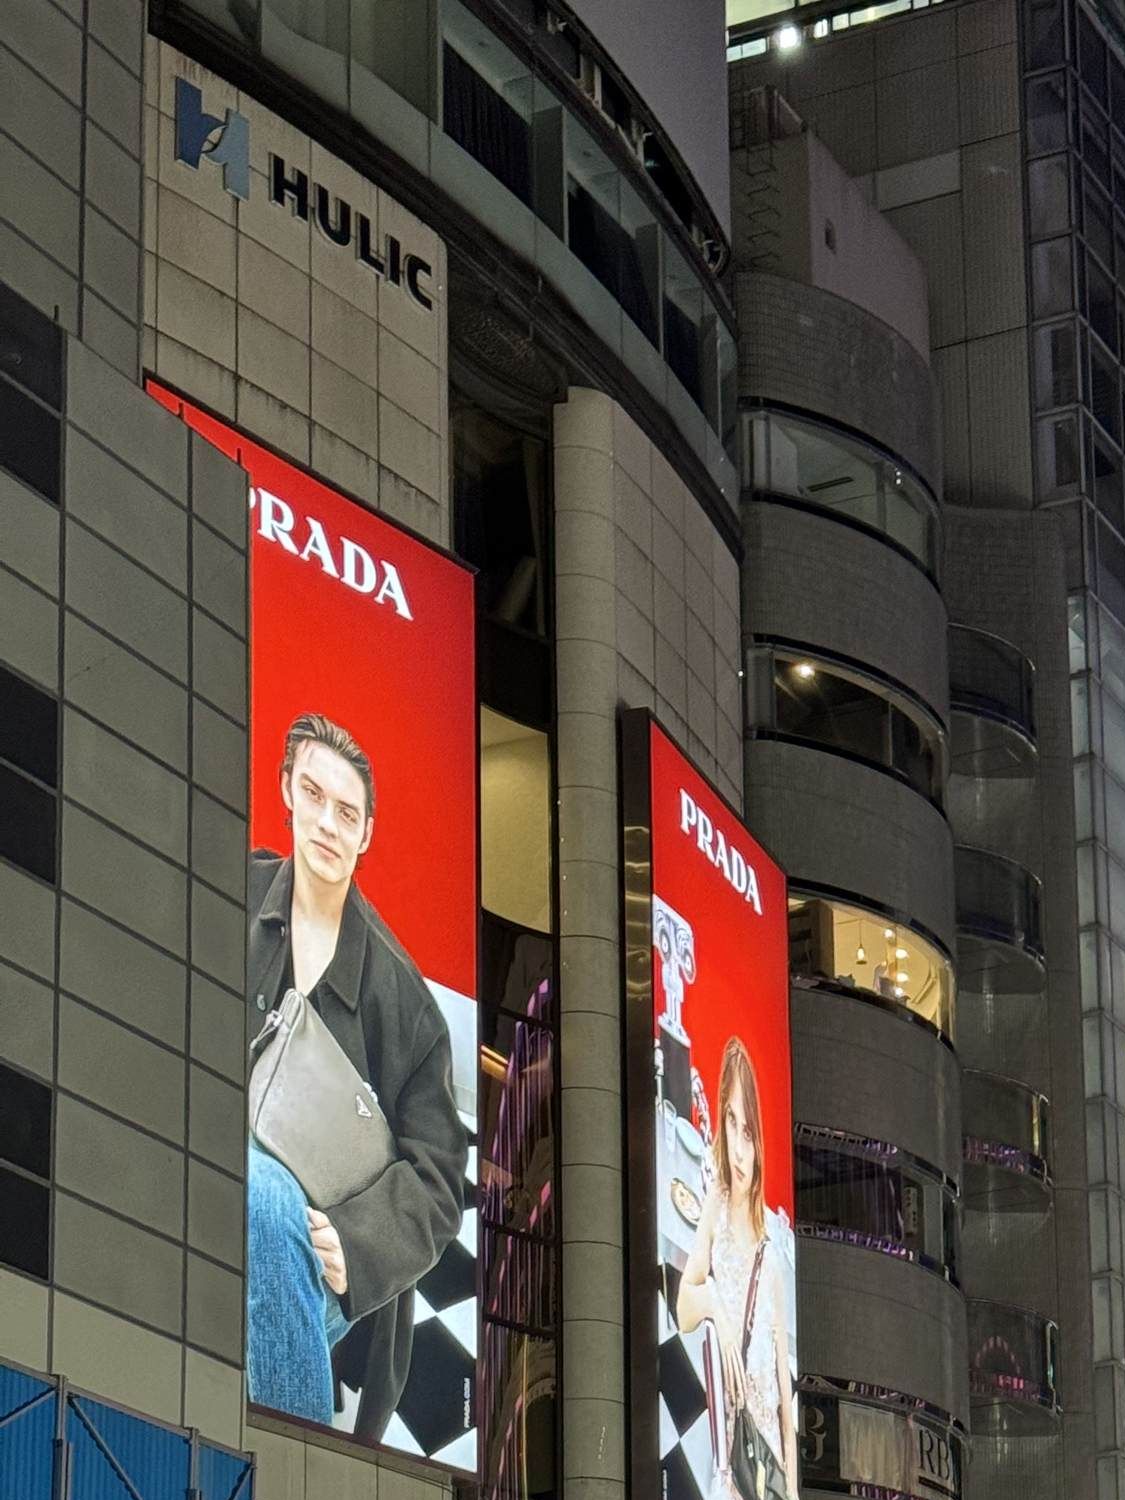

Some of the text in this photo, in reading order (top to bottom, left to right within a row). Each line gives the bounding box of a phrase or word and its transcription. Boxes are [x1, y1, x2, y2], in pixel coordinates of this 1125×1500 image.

[269, 153, 433, 311] HULIC
[250, 487, 414, 621] RADA
[679, 787, 763, 916] PRADA
